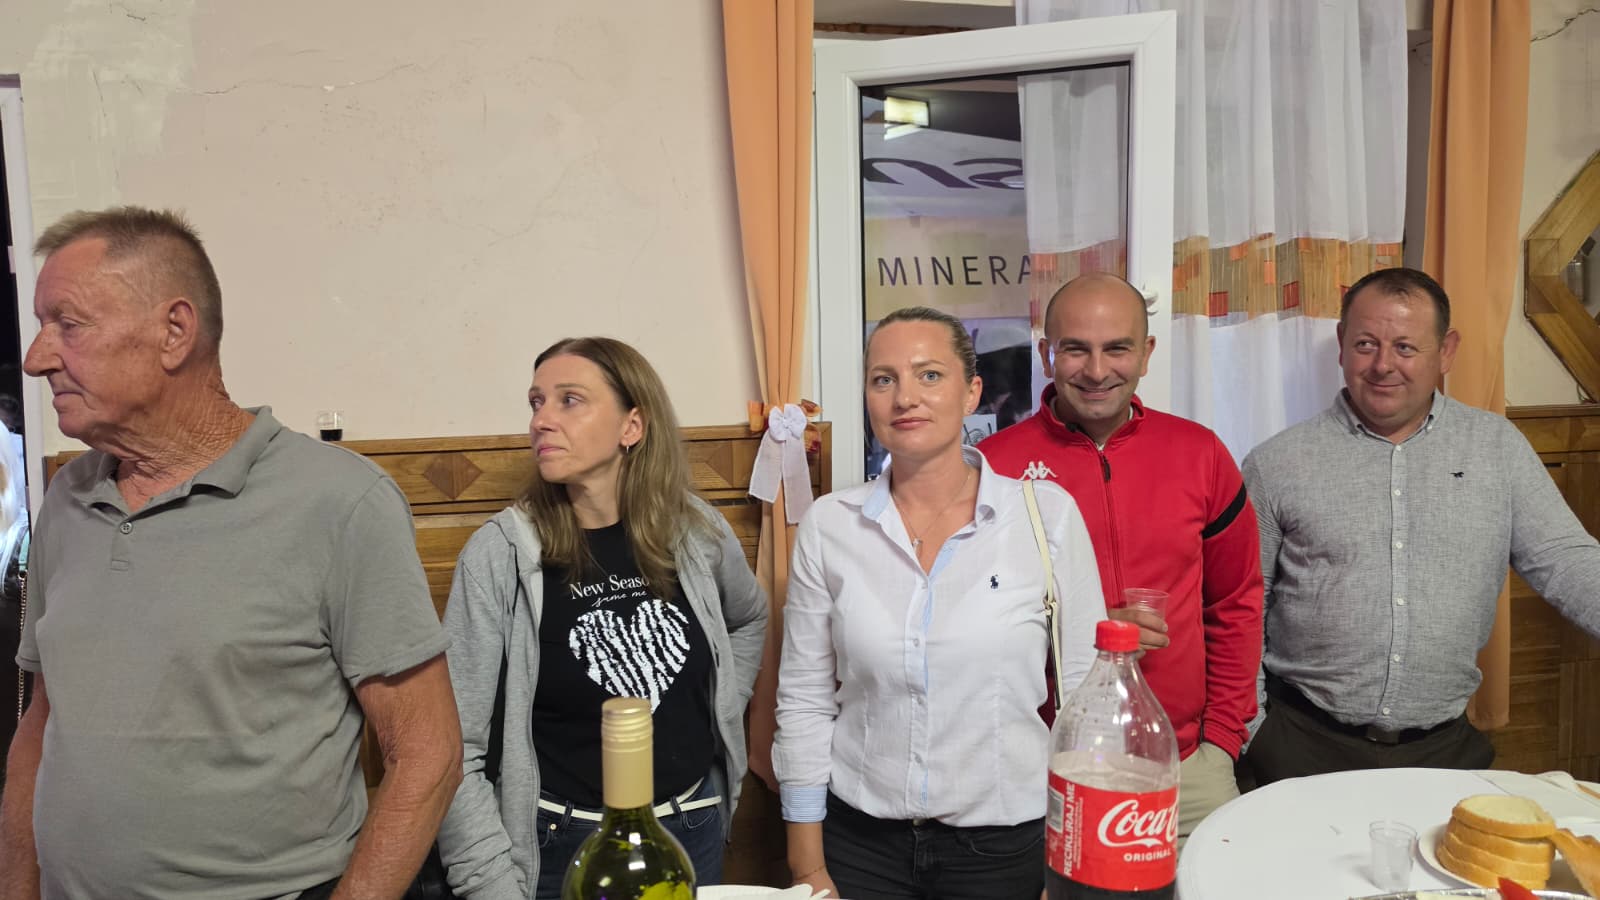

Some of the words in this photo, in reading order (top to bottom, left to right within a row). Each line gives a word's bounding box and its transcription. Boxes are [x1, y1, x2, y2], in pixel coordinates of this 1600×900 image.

[569, 582, 604, 600] New
[1066, 782, 1076, 803] ME
[1063, 803, 1075, 877] RECIKLIRAJ
[1123, 848, 1172, 863] ORIGINAL
